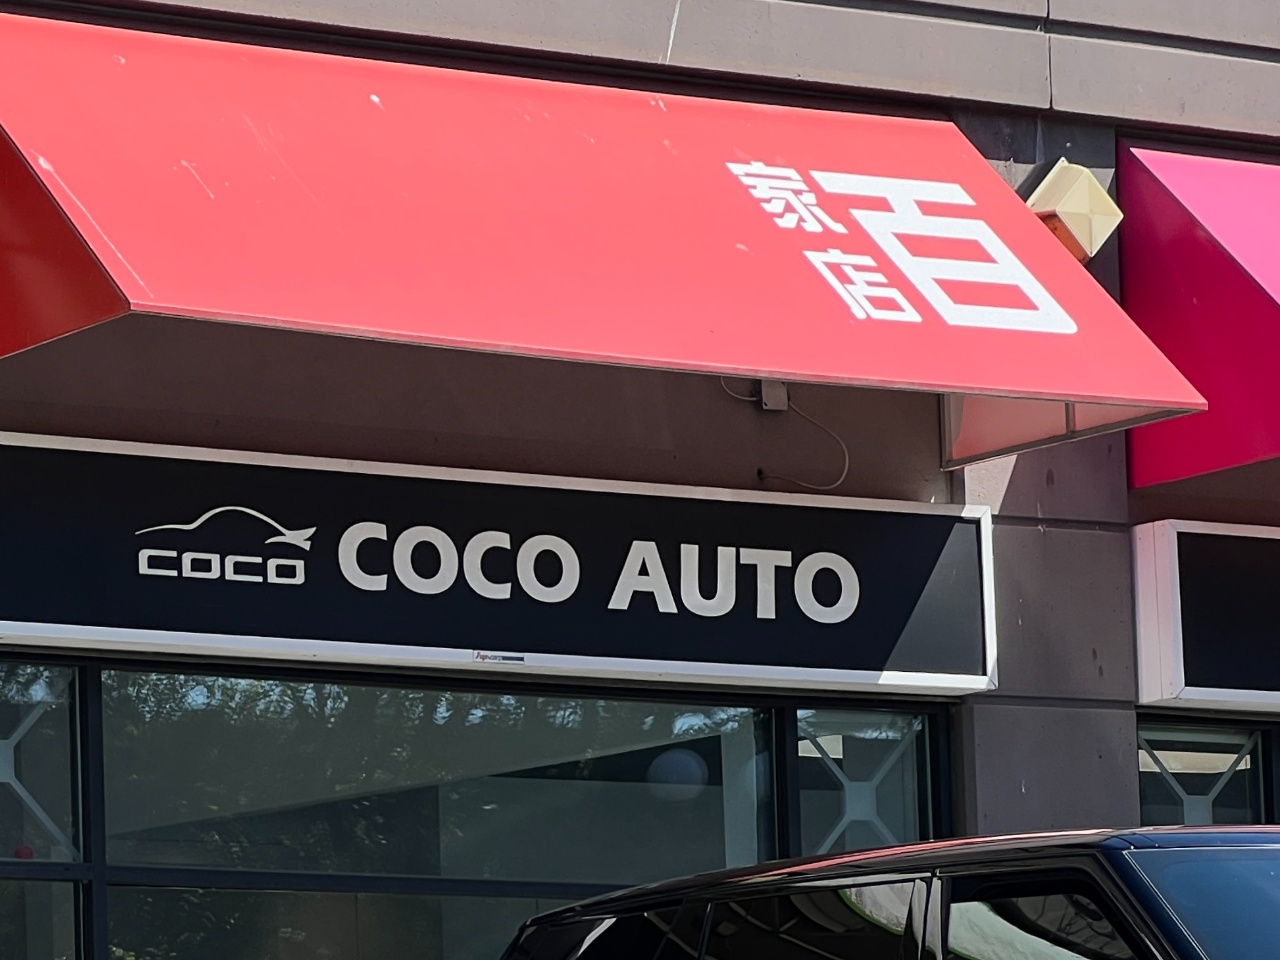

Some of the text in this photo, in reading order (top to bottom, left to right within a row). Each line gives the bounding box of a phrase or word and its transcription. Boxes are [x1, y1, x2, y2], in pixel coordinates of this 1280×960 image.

[810, 170, 1078, 334] 百
[137, 547, 306, 586] COCO
[337, 521, 861, 624] COCO AUTO
